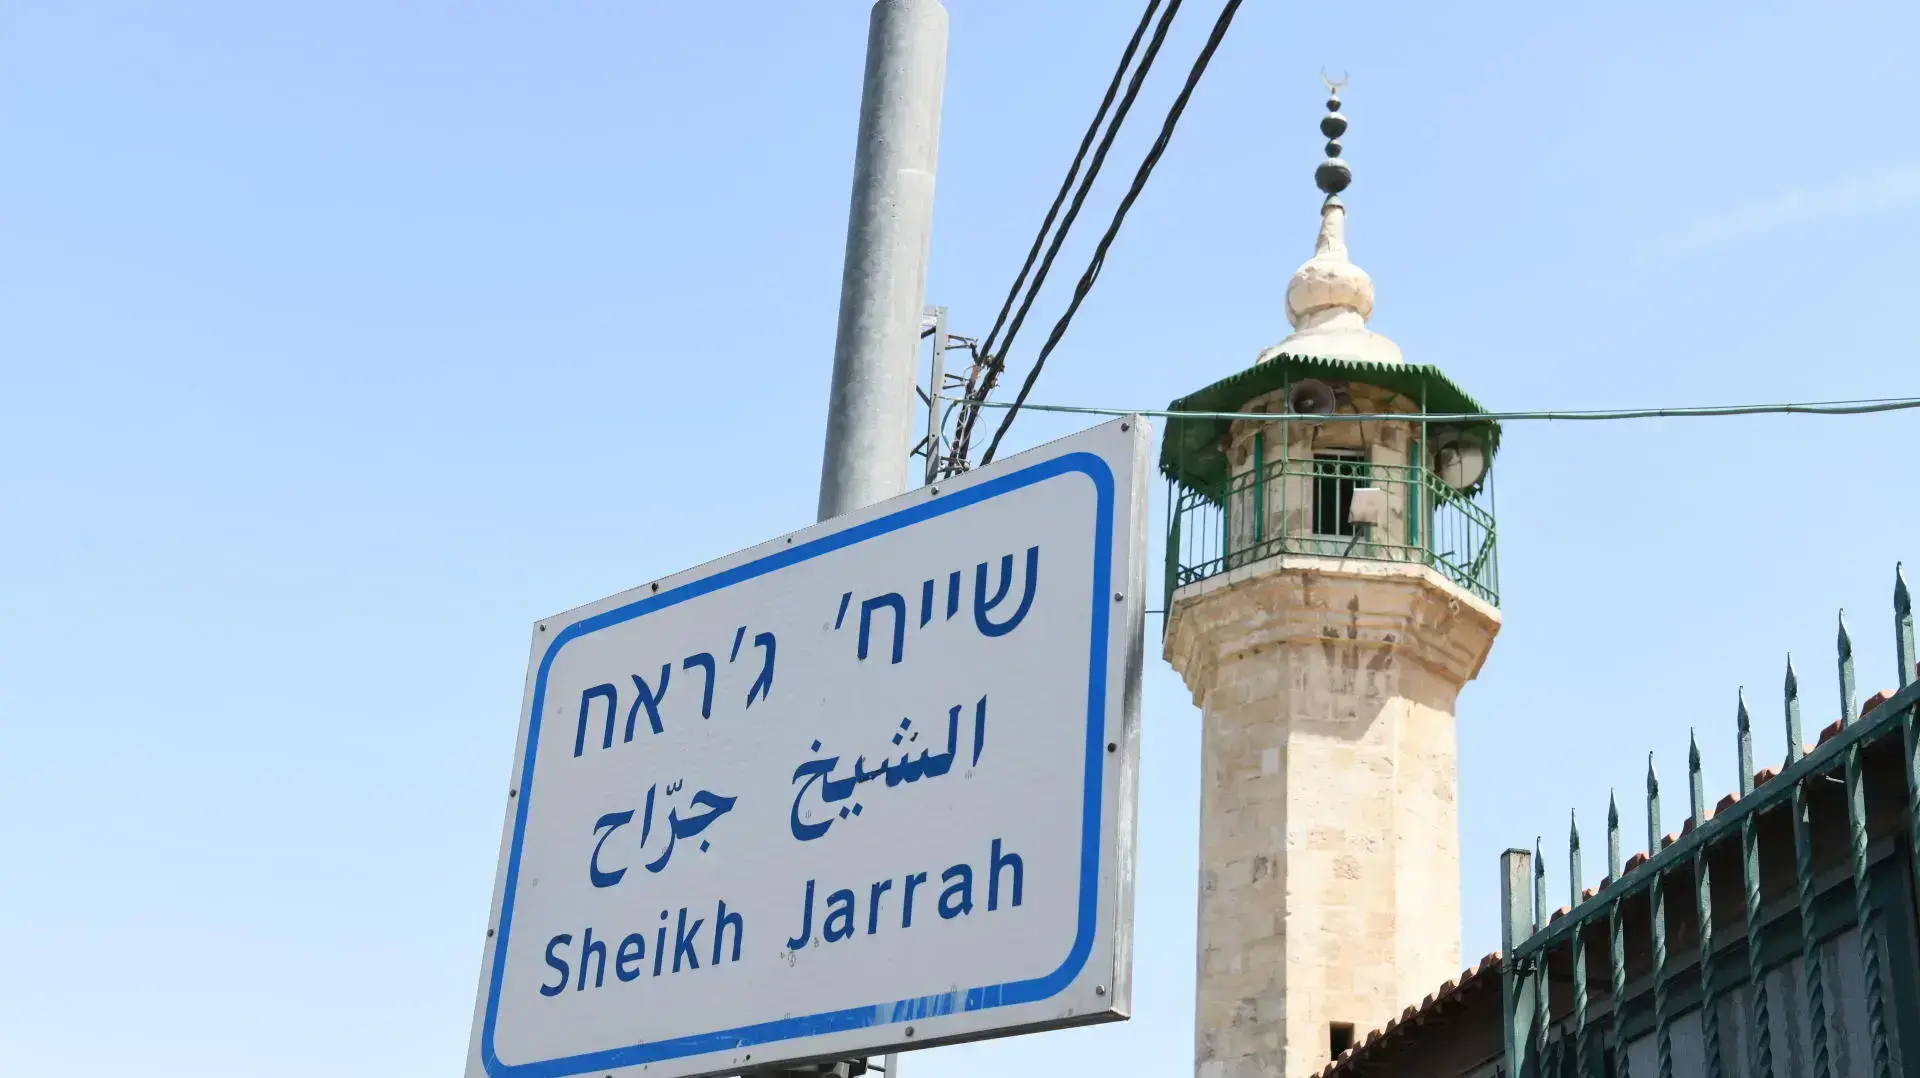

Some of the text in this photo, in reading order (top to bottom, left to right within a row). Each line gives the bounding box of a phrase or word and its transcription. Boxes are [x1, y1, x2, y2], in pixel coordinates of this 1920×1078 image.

[589, 694, 988, 889] الشيخ جرّاح
[539, 837, 1024, 997] Sheikh Jarrah
